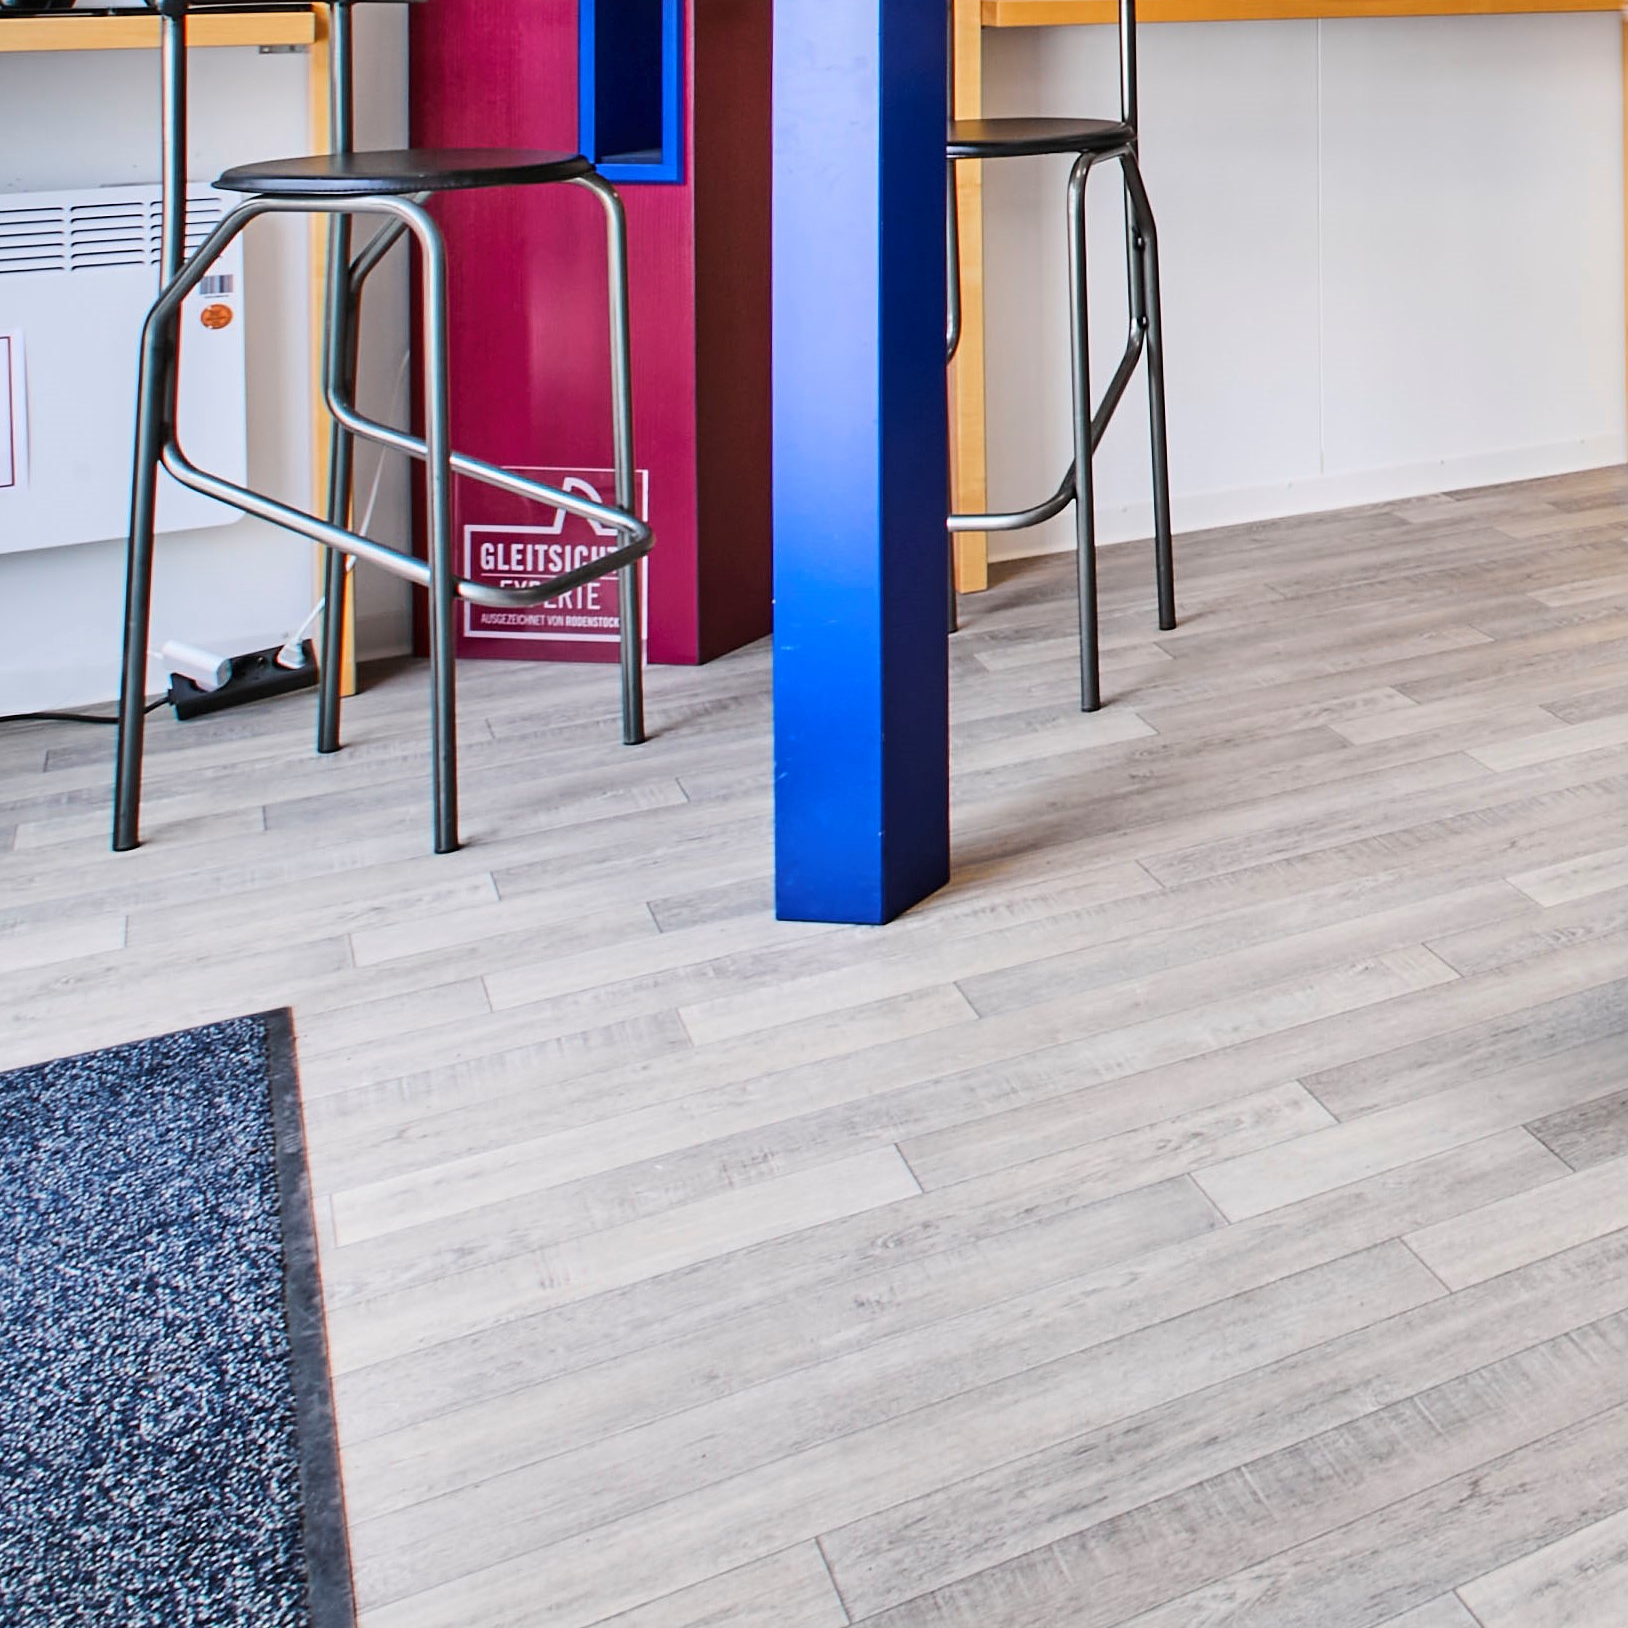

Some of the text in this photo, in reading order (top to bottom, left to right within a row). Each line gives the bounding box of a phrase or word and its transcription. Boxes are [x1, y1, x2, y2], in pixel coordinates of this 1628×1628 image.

[480, 541, 618, 574] GLEITSIC
[481, 613, 620, 628] AUSGEZEICHNET VON RODENSTOCK
